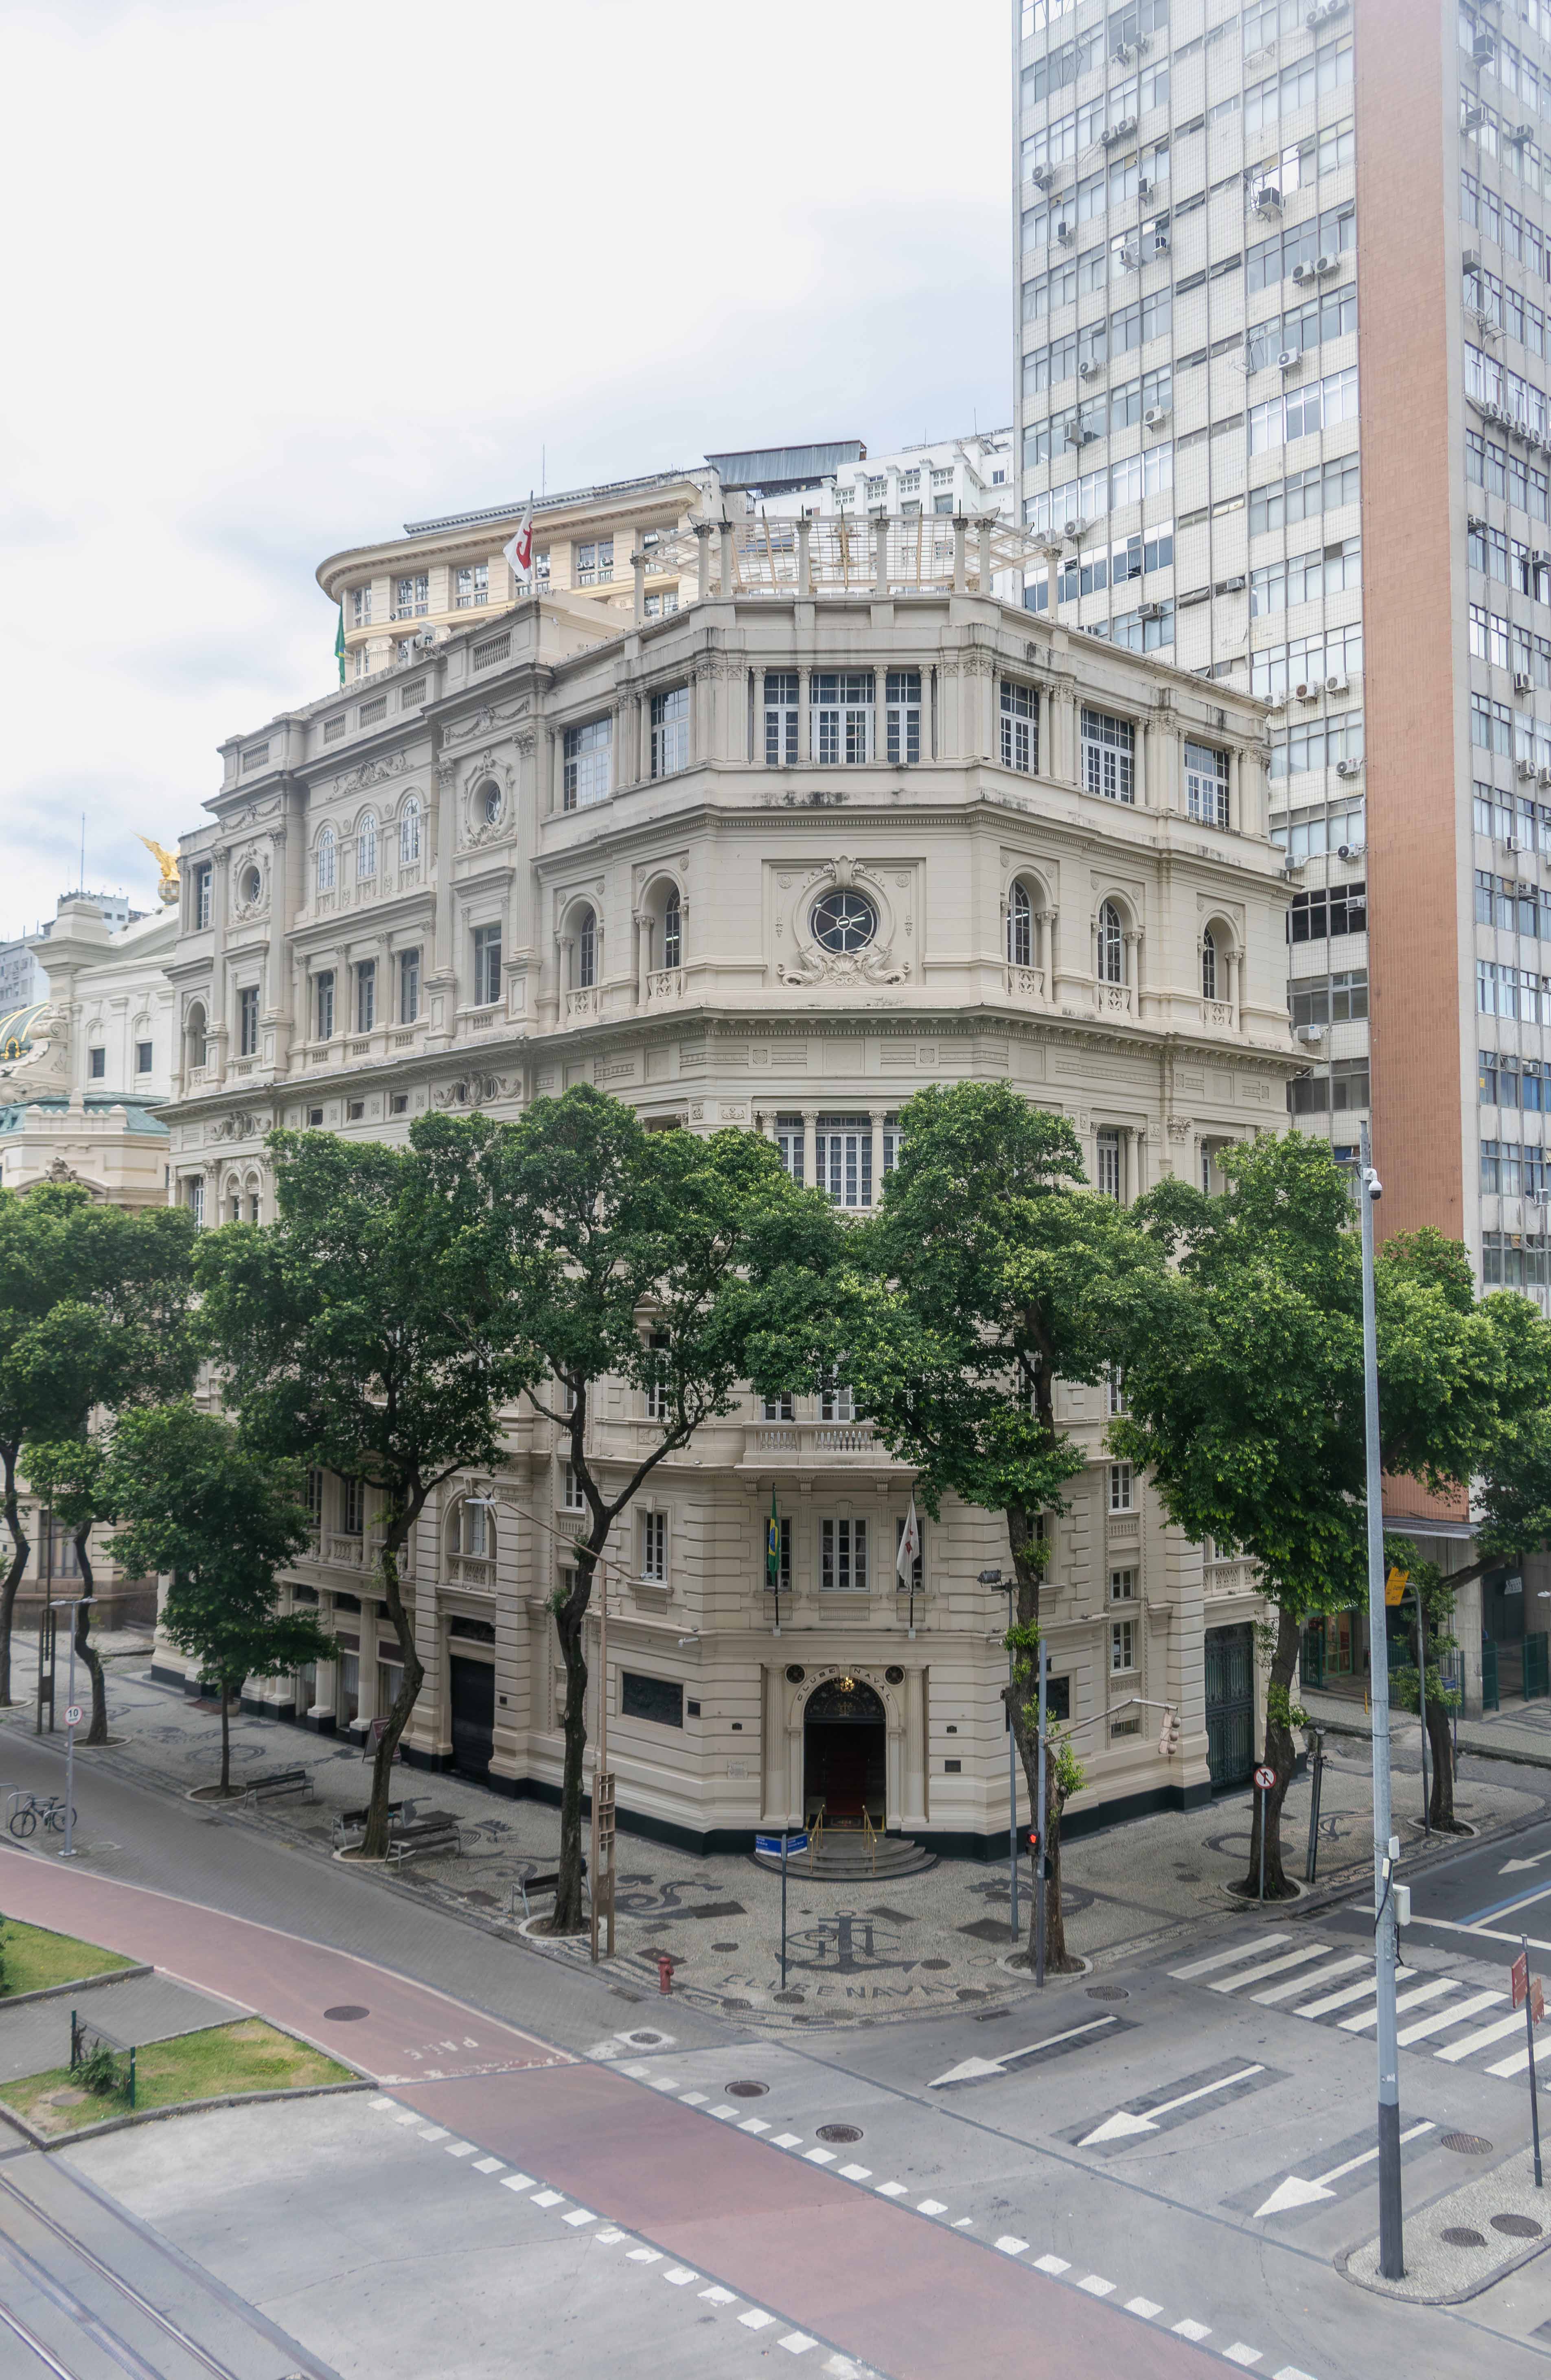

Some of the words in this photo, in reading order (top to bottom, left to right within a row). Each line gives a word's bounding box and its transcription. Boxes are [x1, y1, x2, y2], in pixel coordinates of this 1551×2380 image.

[797, 1667, 835, 1702] CLUBE
[854, 1668, 889, 1701] NAVAL
[68, 1709, 79, 1717] 10
[723, 1974, 836, 1997] CLUBE
[846, 1981, 960, 1998] NAVAL
